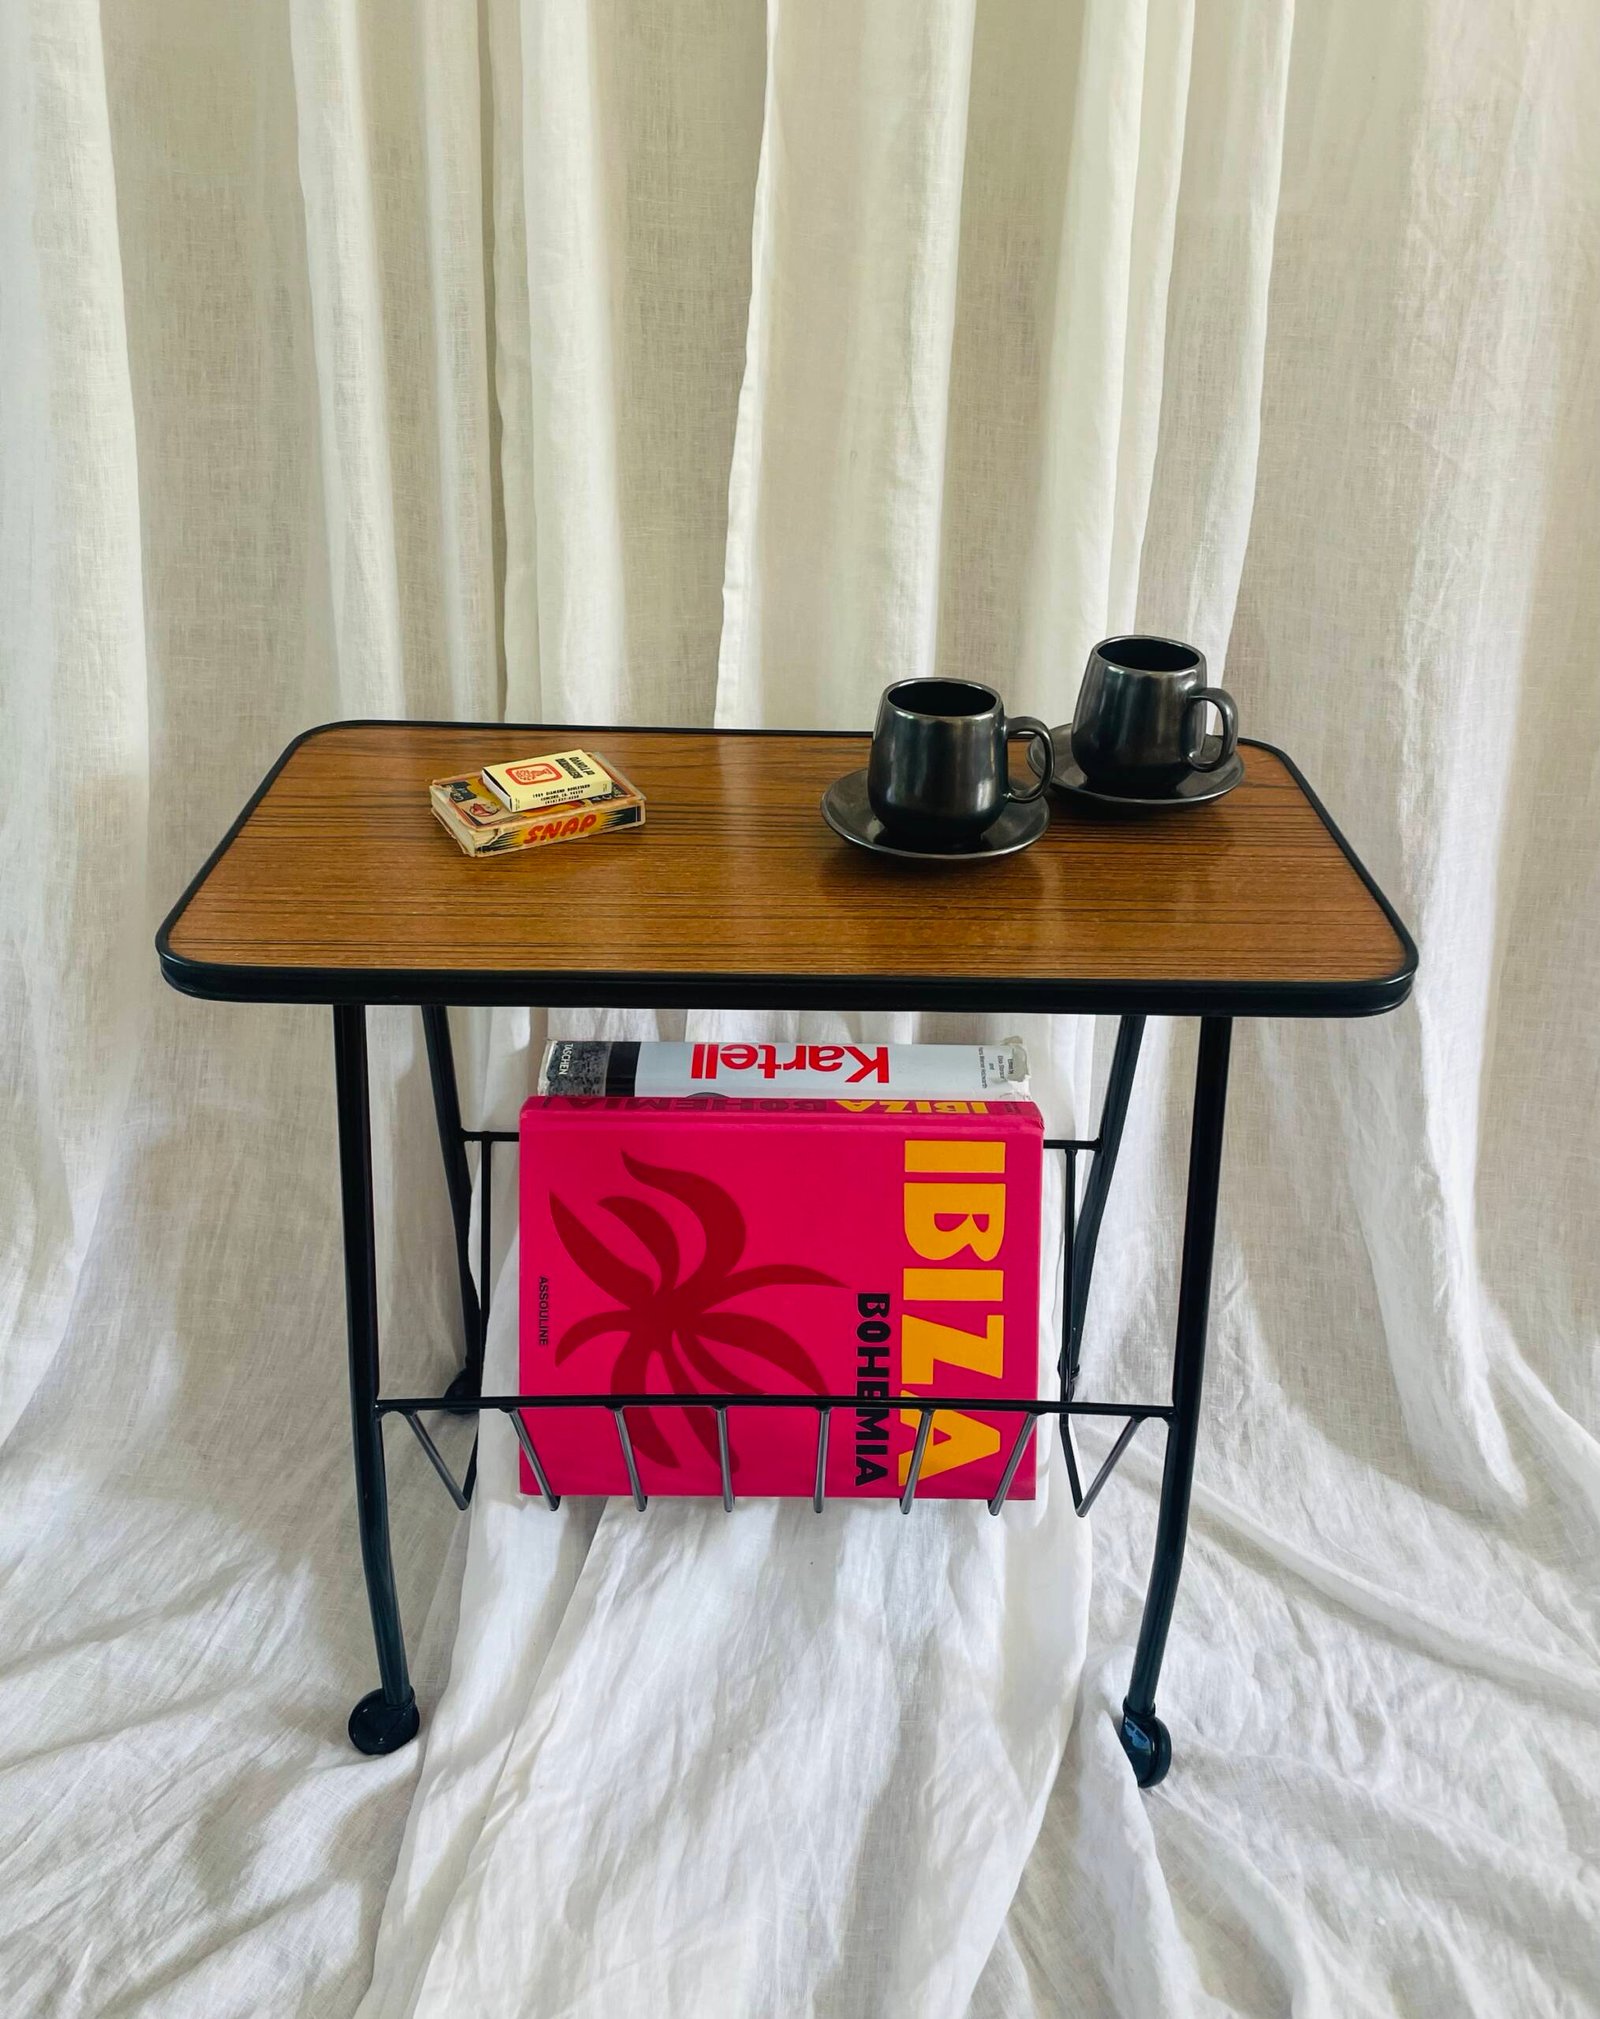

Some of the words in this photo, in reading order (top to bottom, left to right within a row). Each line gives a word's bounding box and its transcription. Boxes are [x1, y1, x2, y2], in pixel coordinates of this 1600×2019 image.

[523, 813, 597, 844] SNAP
[559, 1043, 574, 1075] TASCHEN
[691, 1043, 889, 1084] Kartell
[834, 1100, 988, 1114] IBIZA
[538, 1276, 549, 1346] ASSOULINE
[899, 1139, 1006, 1487] IBIZA
[855, 1292, 892, 1487] BOHEMIA
